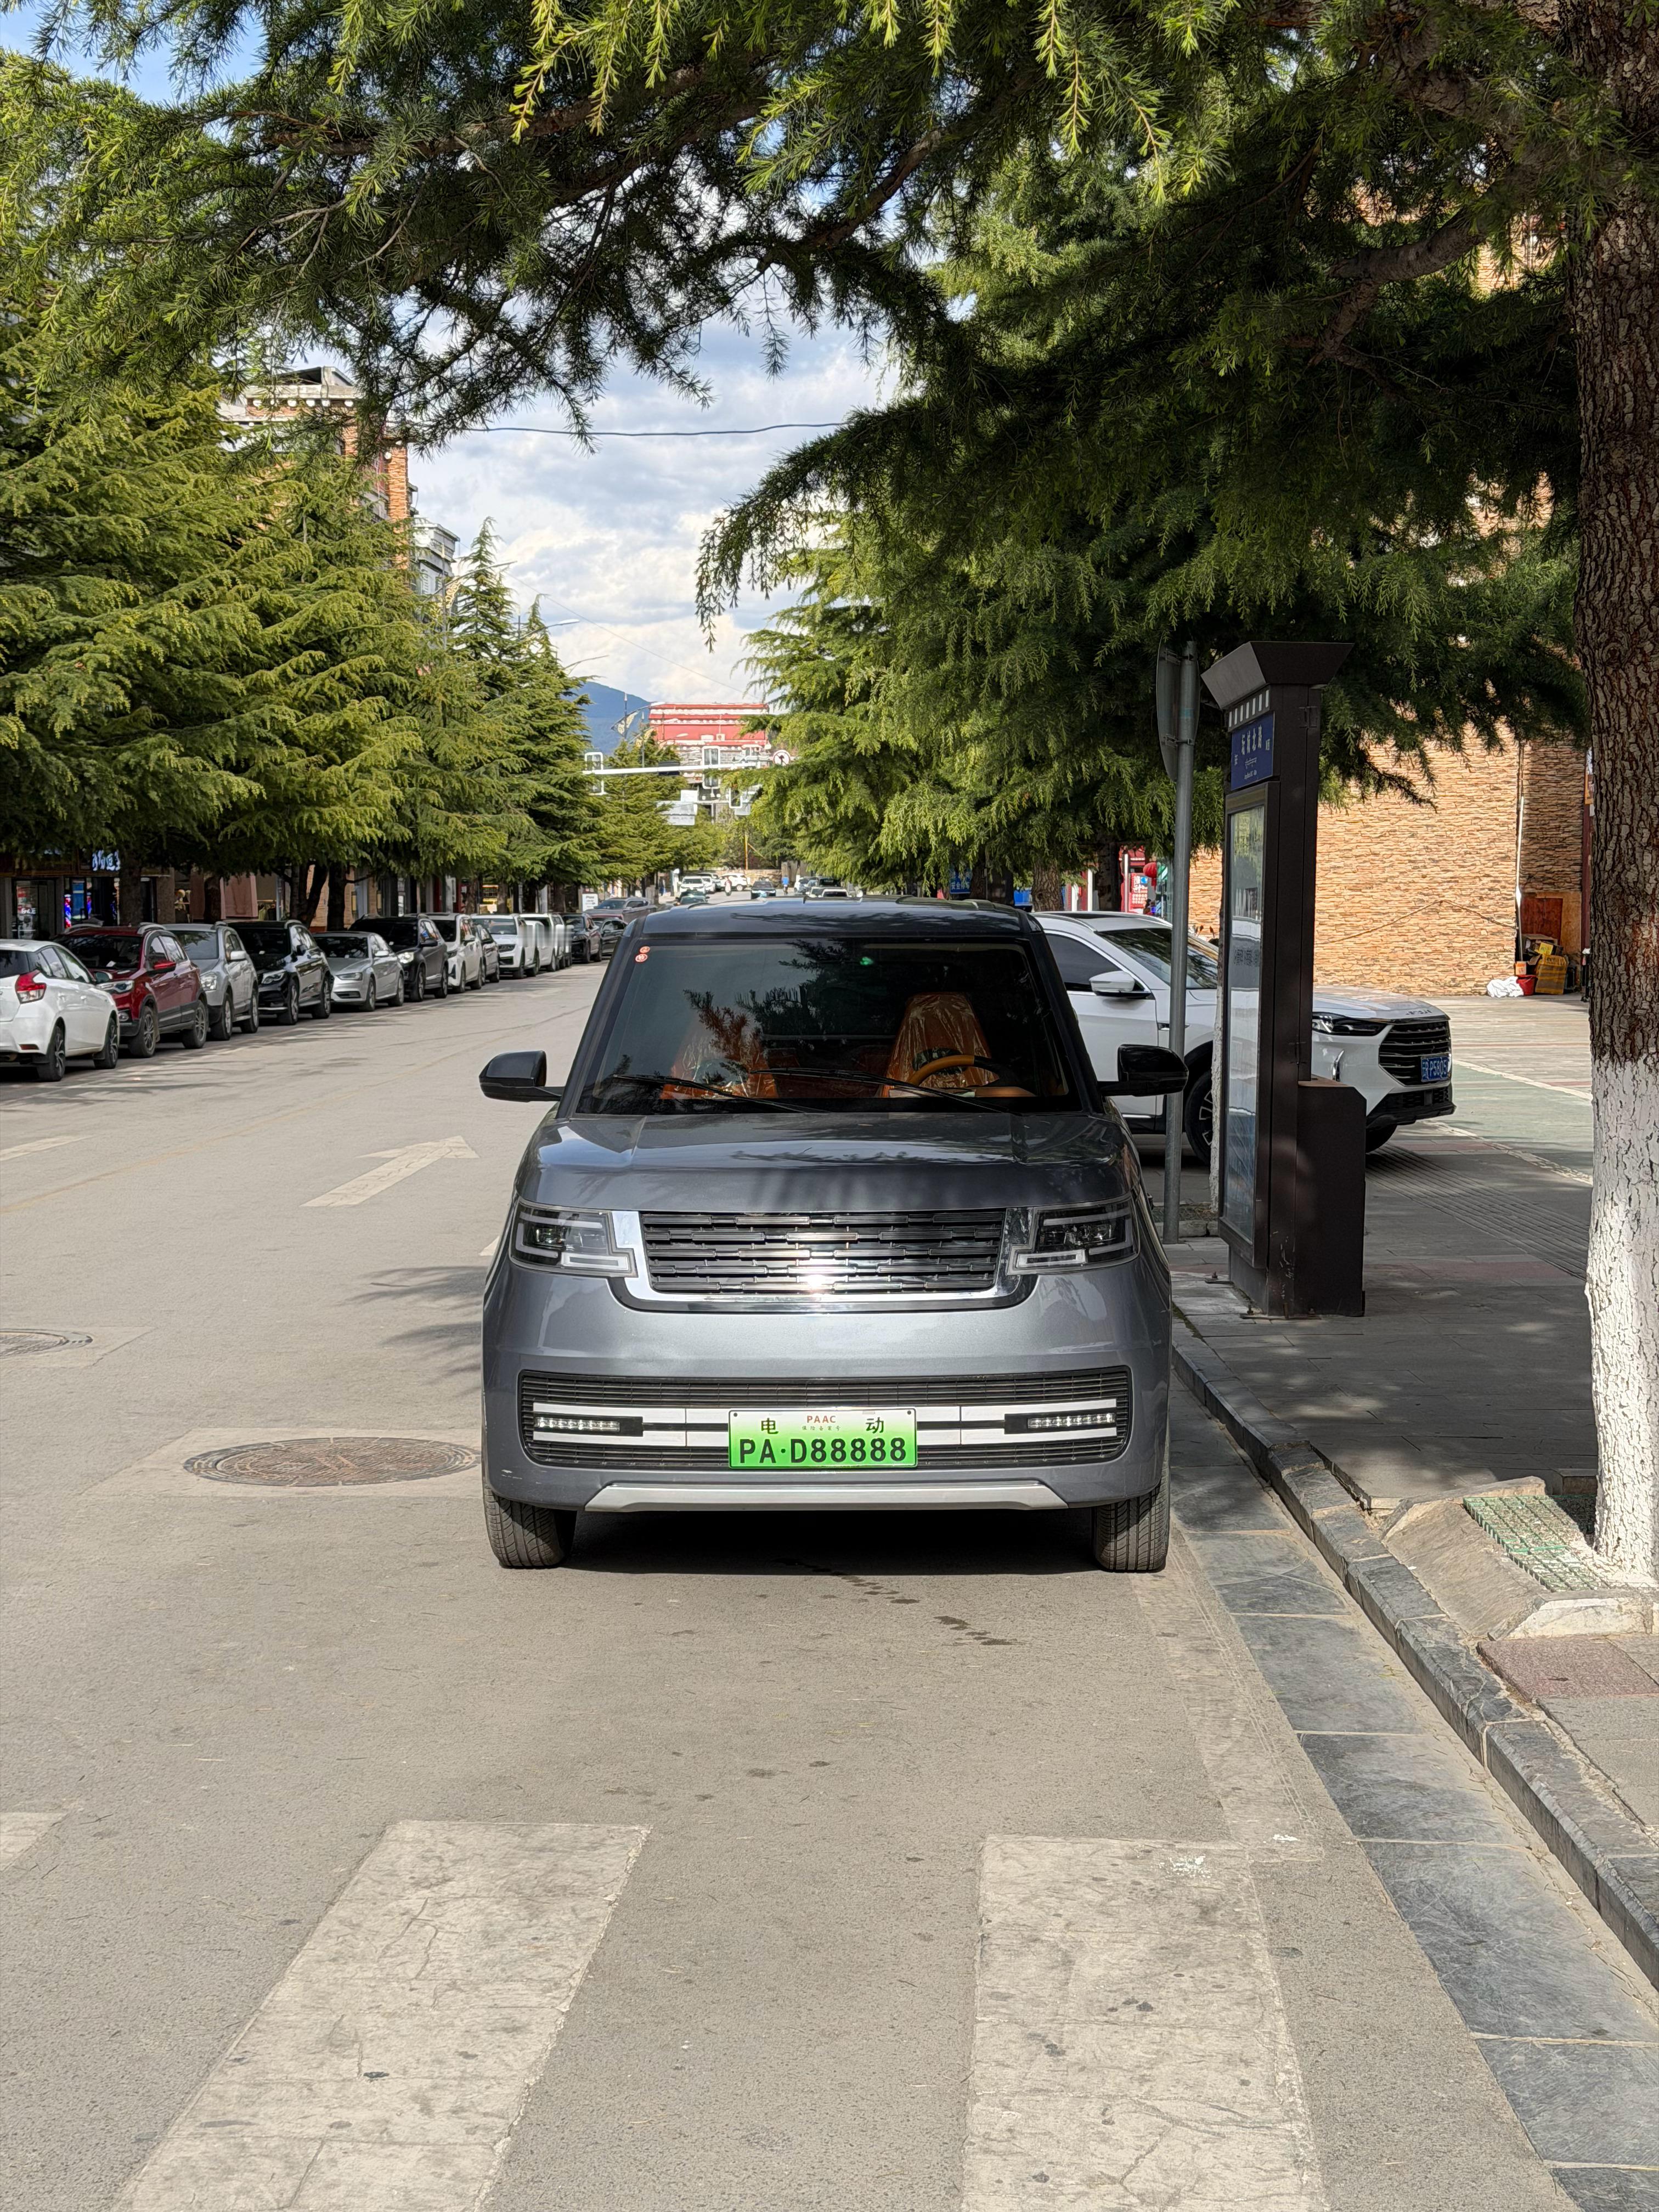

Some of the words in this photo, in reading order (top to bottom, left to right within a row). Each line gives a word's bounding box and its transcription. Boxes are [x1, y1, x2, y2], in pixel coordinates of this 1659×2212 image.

[761, 1418, 779, 1435] 电
[806, 1415, 836, 1423] PAAC
[866, 1417, 884, 1434] 动
[740, 1437, 906, 1463] PA·D88888
